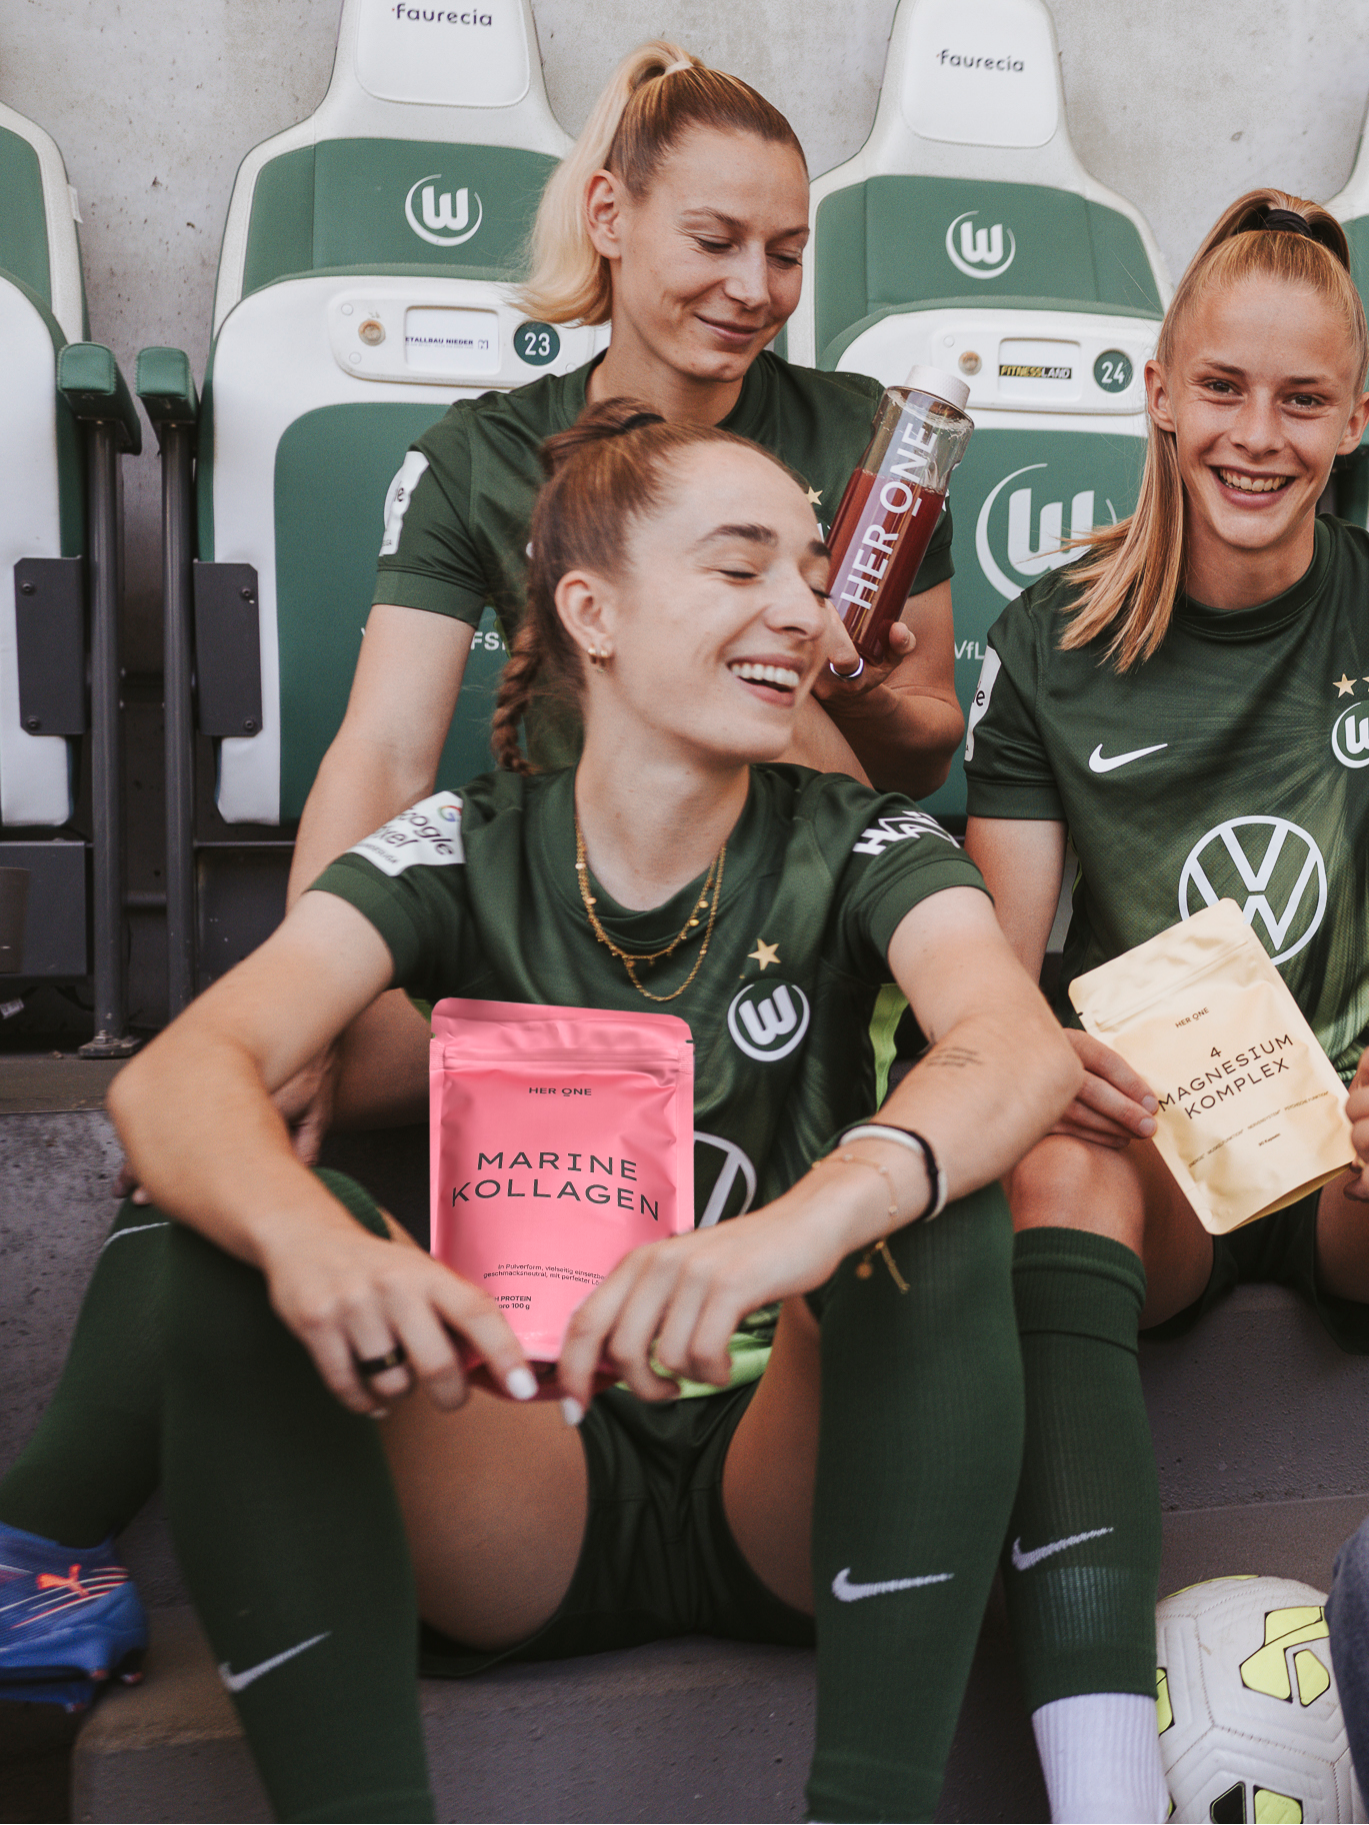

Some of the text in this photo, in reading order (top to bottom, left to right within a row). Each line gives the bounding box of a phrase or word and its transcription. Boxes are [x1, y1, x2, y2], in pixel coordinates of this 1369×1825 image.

[396, 3, 493, 26] faurecia
[941, 48, 1024, 72] faurecia
[524, 332, 551, 357] 23
[1101, 361, 1125, 384] 24
[840, 422, 938, 610] HER ONE
[1175, 1007, 1209, 1028] HER ONE
[1210, 1047, 1221, 1057] 4
[1158, 1034, 1293, 1112] MAGNESIUM
[528, 1087, 592, 1097] HER ONE
[1184, 1058, 1289, 1119] KOMPLEX
[477, 1152, 638, 1181] MARINE
[452, 1179, 658, 1222] KOLLAGEN
